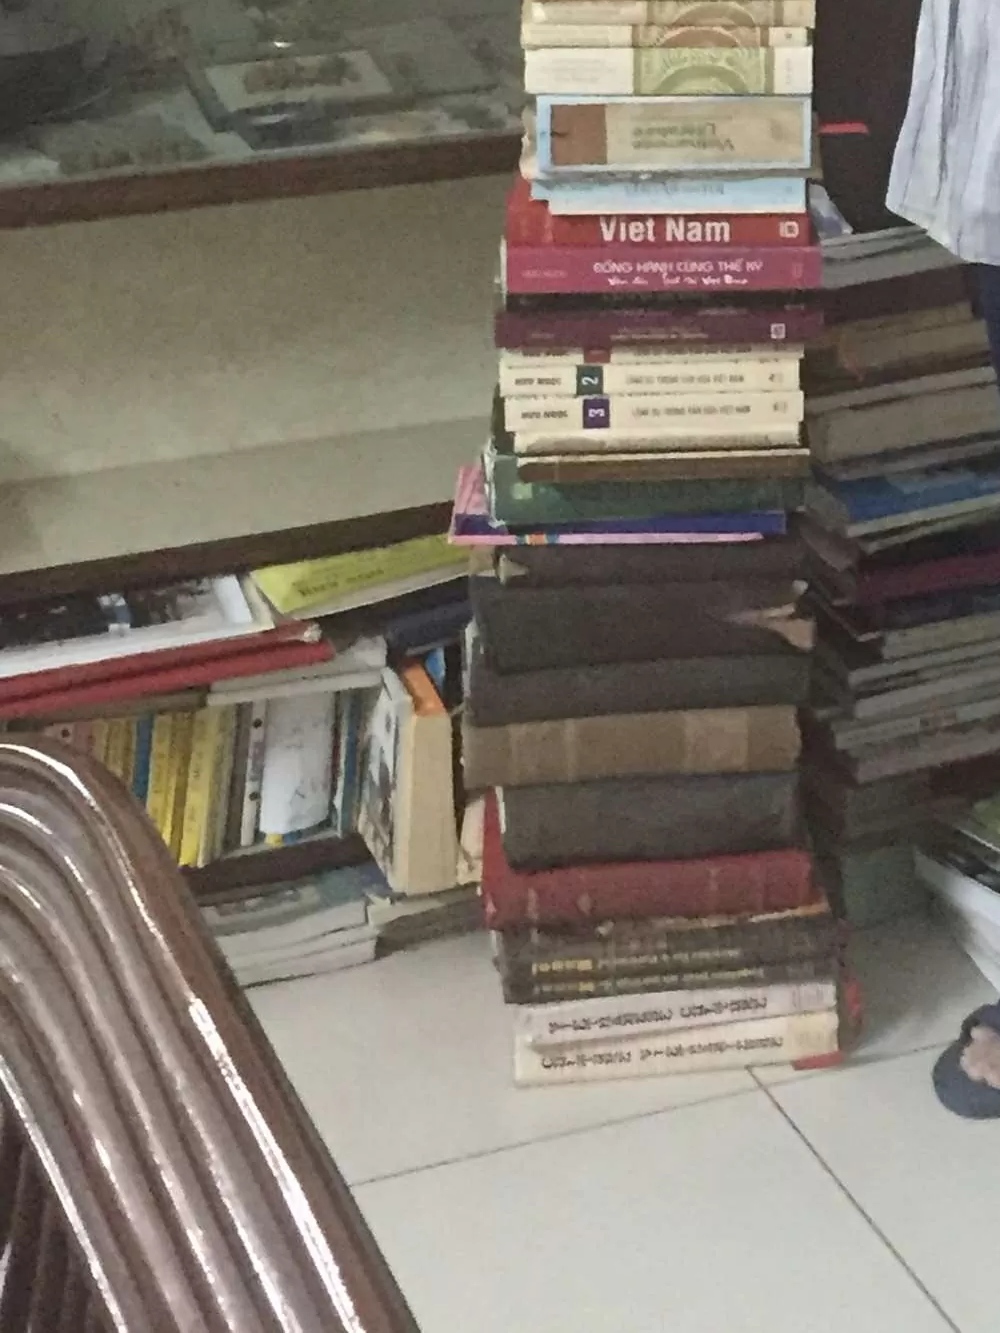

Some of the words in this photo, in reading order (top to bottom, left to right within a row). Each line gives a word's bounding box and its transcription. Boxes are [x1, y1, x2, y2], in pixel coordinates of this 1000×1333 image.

[600, 215, 657, 243] Viet
[665, 215, 731, 243] Nam
[582, 375, 600, 386] 2
[588, 407, 605, 418] 3
